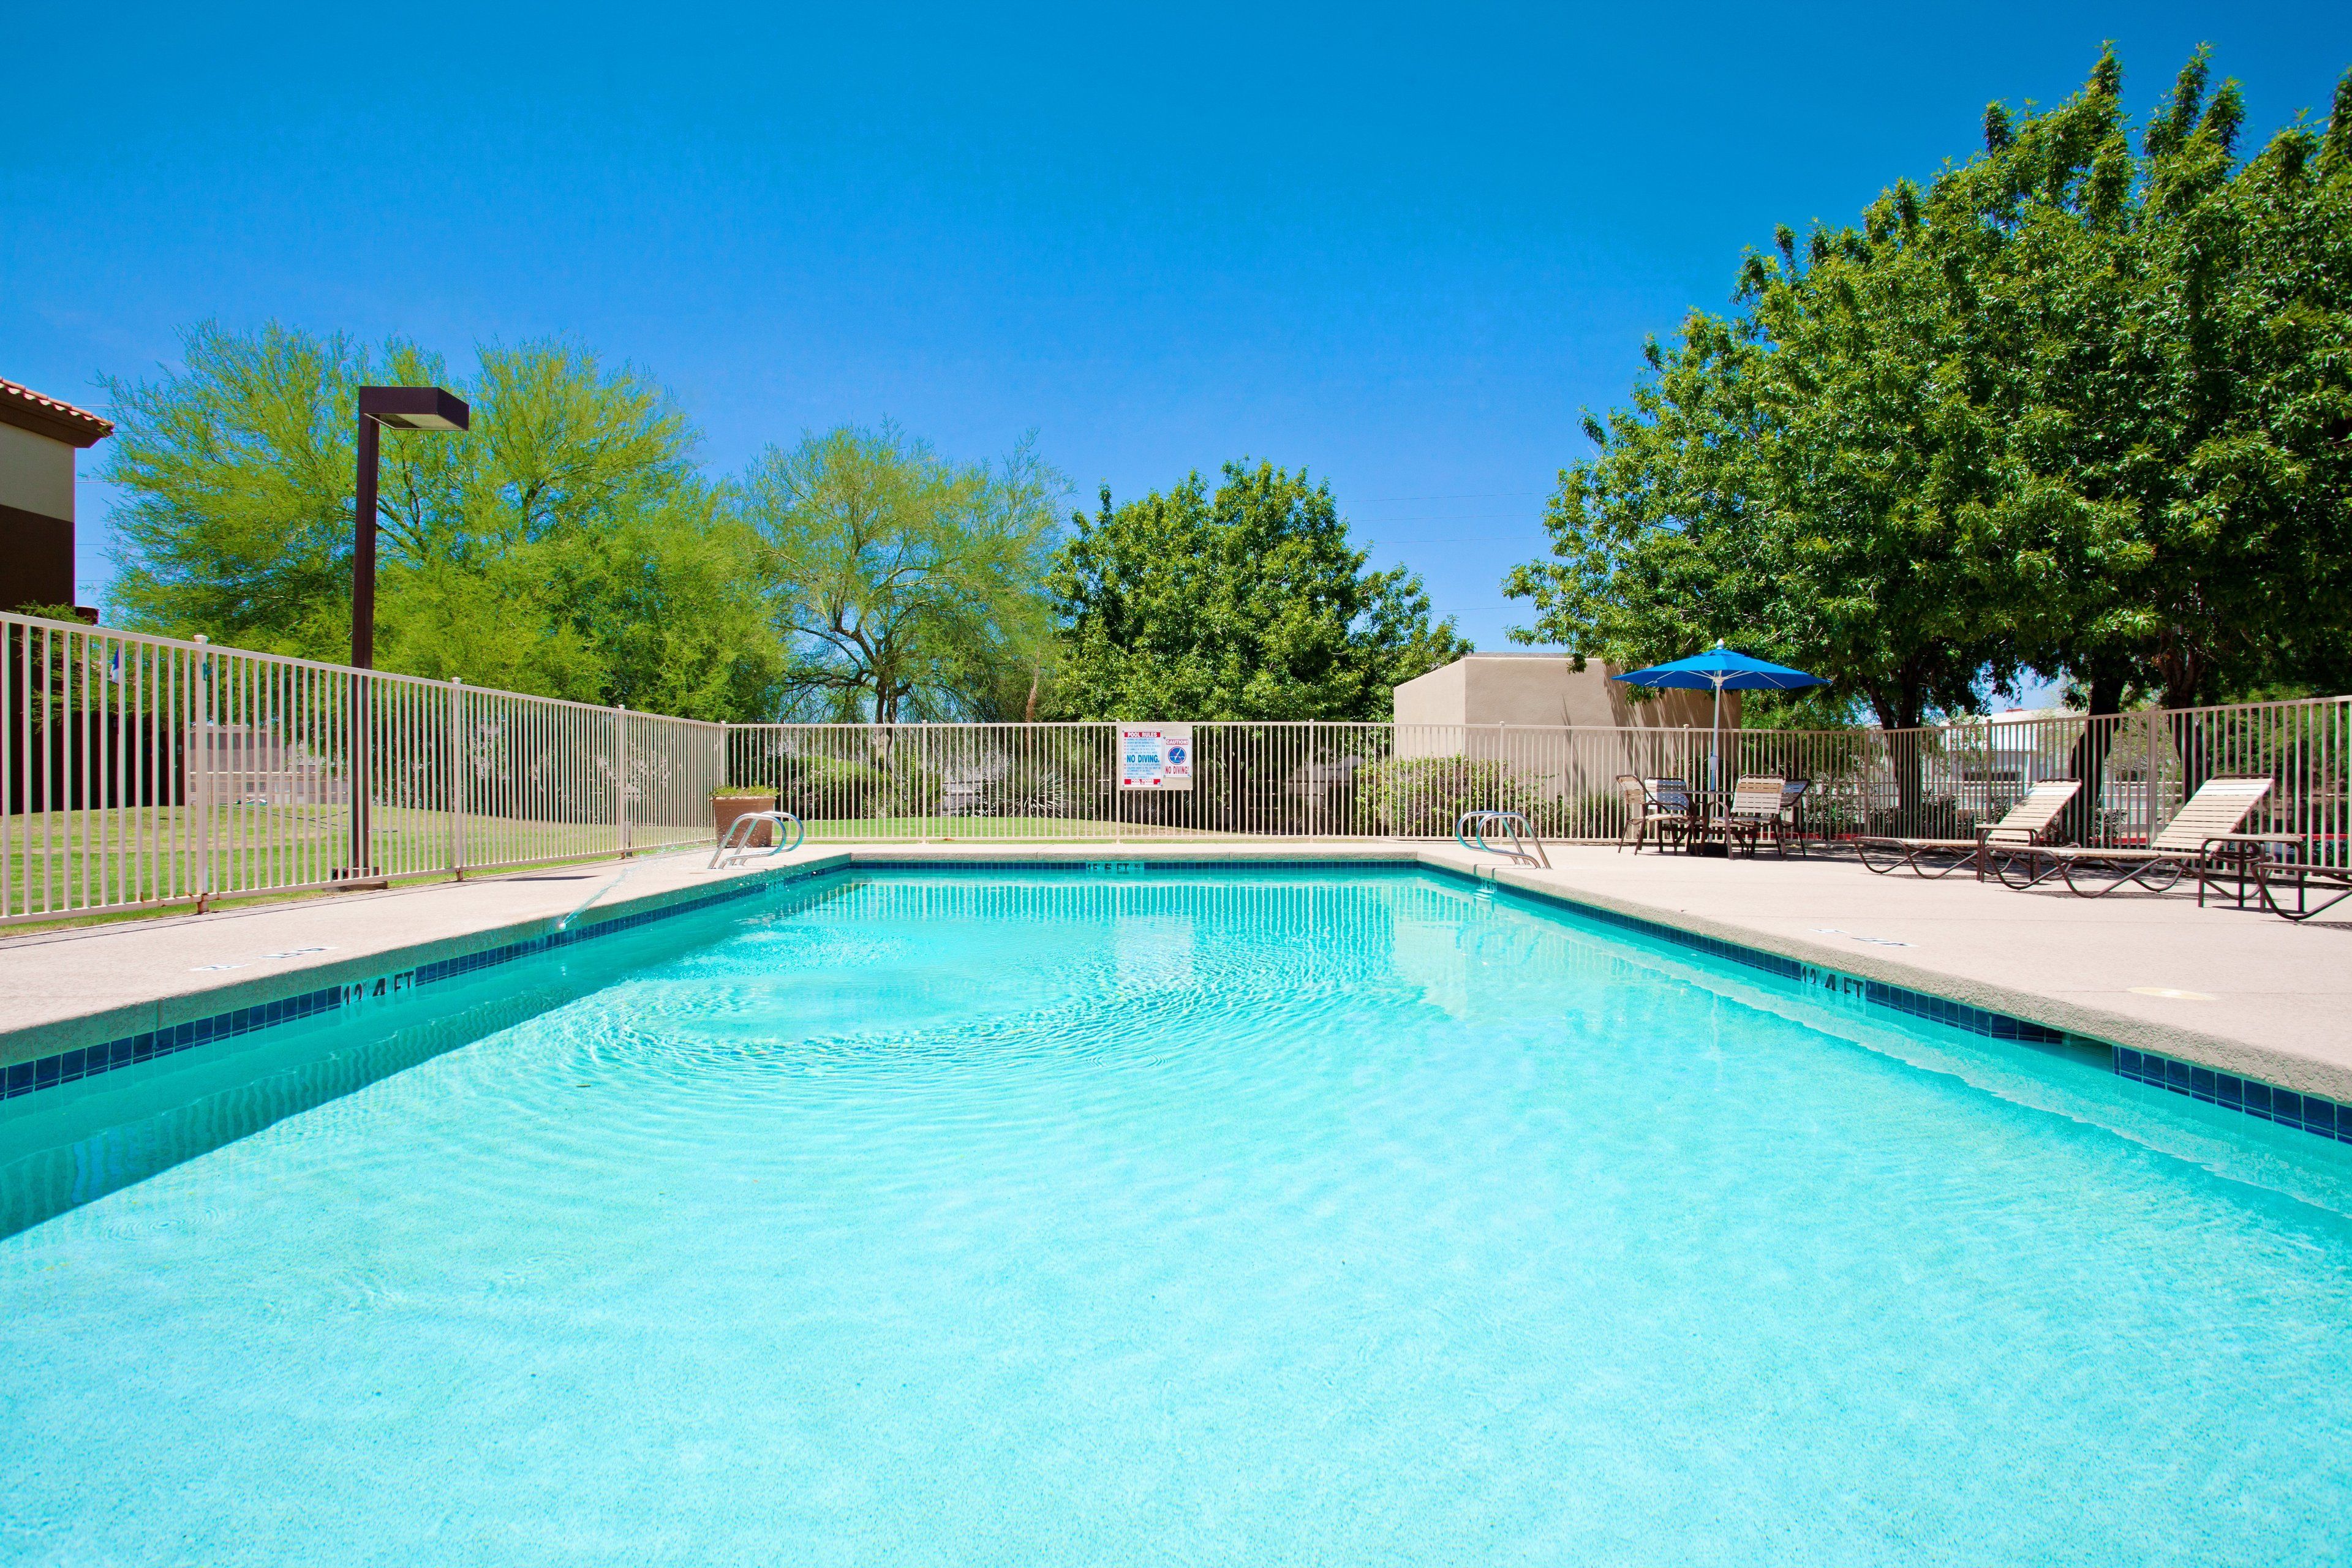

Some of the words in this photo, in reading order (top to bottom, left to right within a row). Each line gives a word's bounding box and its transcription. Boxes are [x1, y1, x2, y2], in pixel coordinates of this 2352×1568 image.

[1127, 755, 1136, 763] NO
[1165, 766, 1171, 774] NO
[1173, 766, 1189, 774] DIVING!
[394, 970, 415, 992] FT
[1843, 976, 1864, 998] FT
